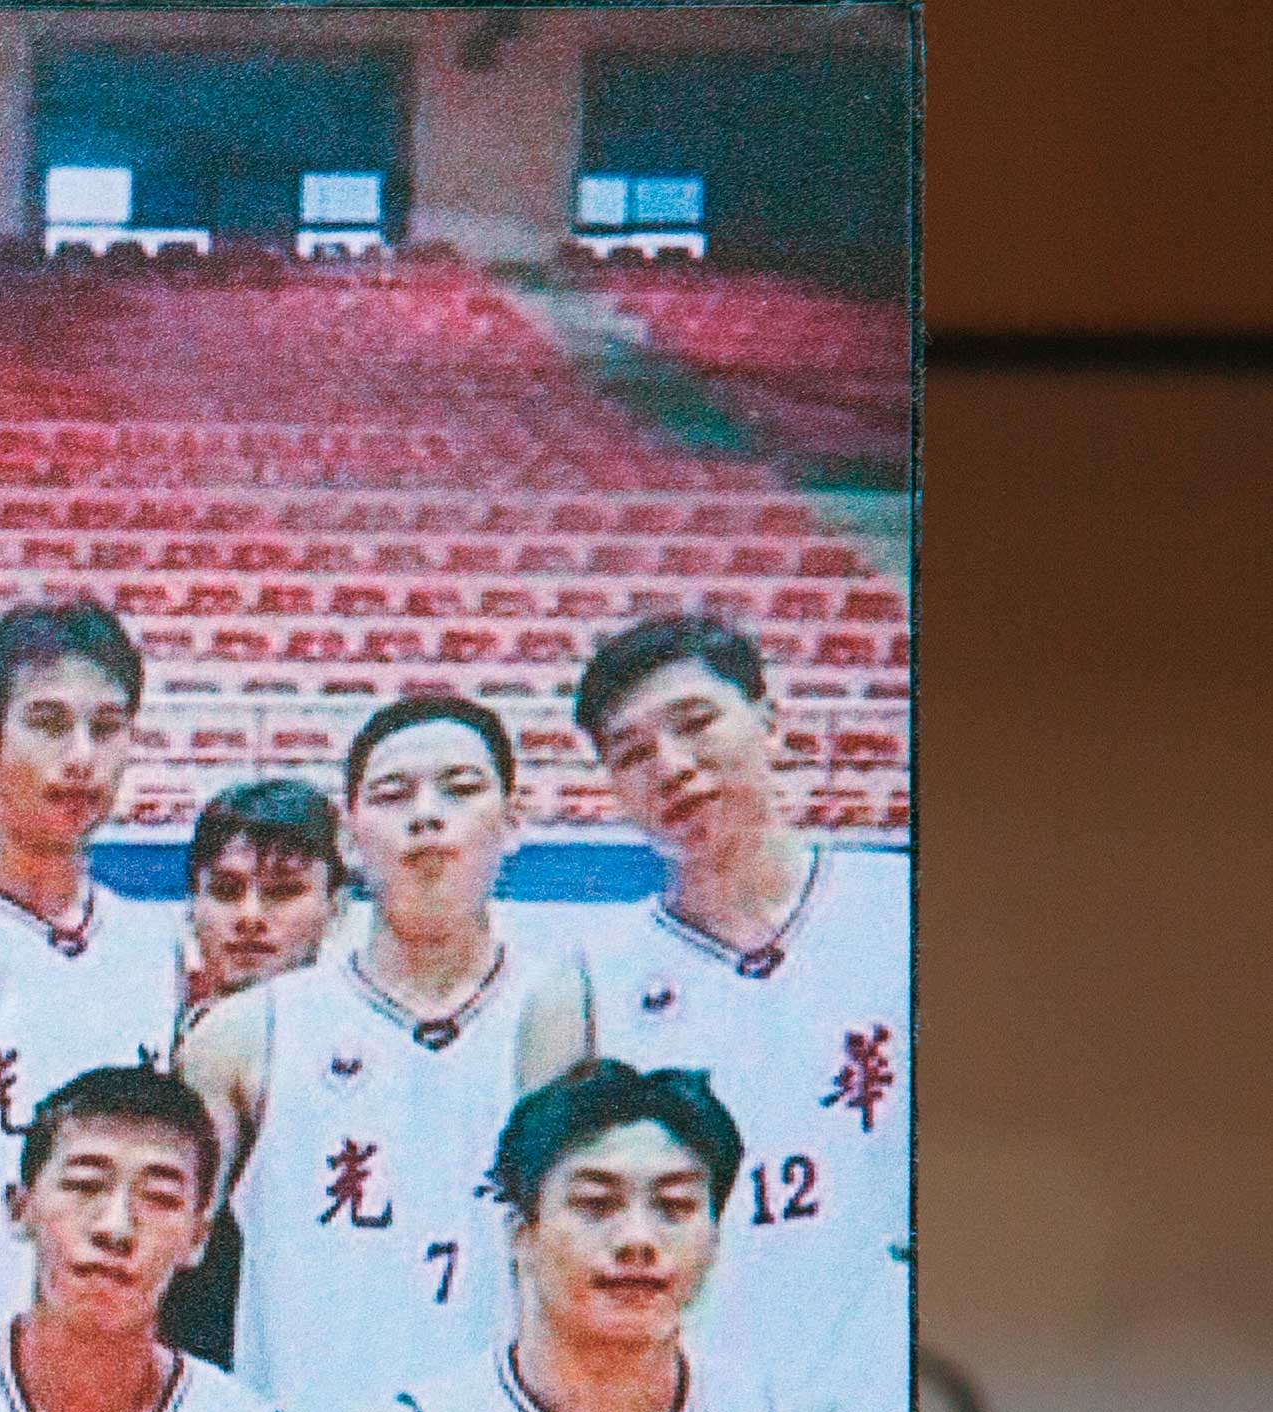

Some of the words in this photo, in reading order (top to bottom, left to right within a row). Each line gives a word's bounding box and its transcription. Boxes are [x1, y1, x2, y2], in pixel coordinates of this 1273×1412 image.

[821, 1025, 894, 1134] 華
[316, 1138, 395, 1229] 光
[750, 1154, 820, 1227] 12
[423, 1240, 458, 1305] 7
